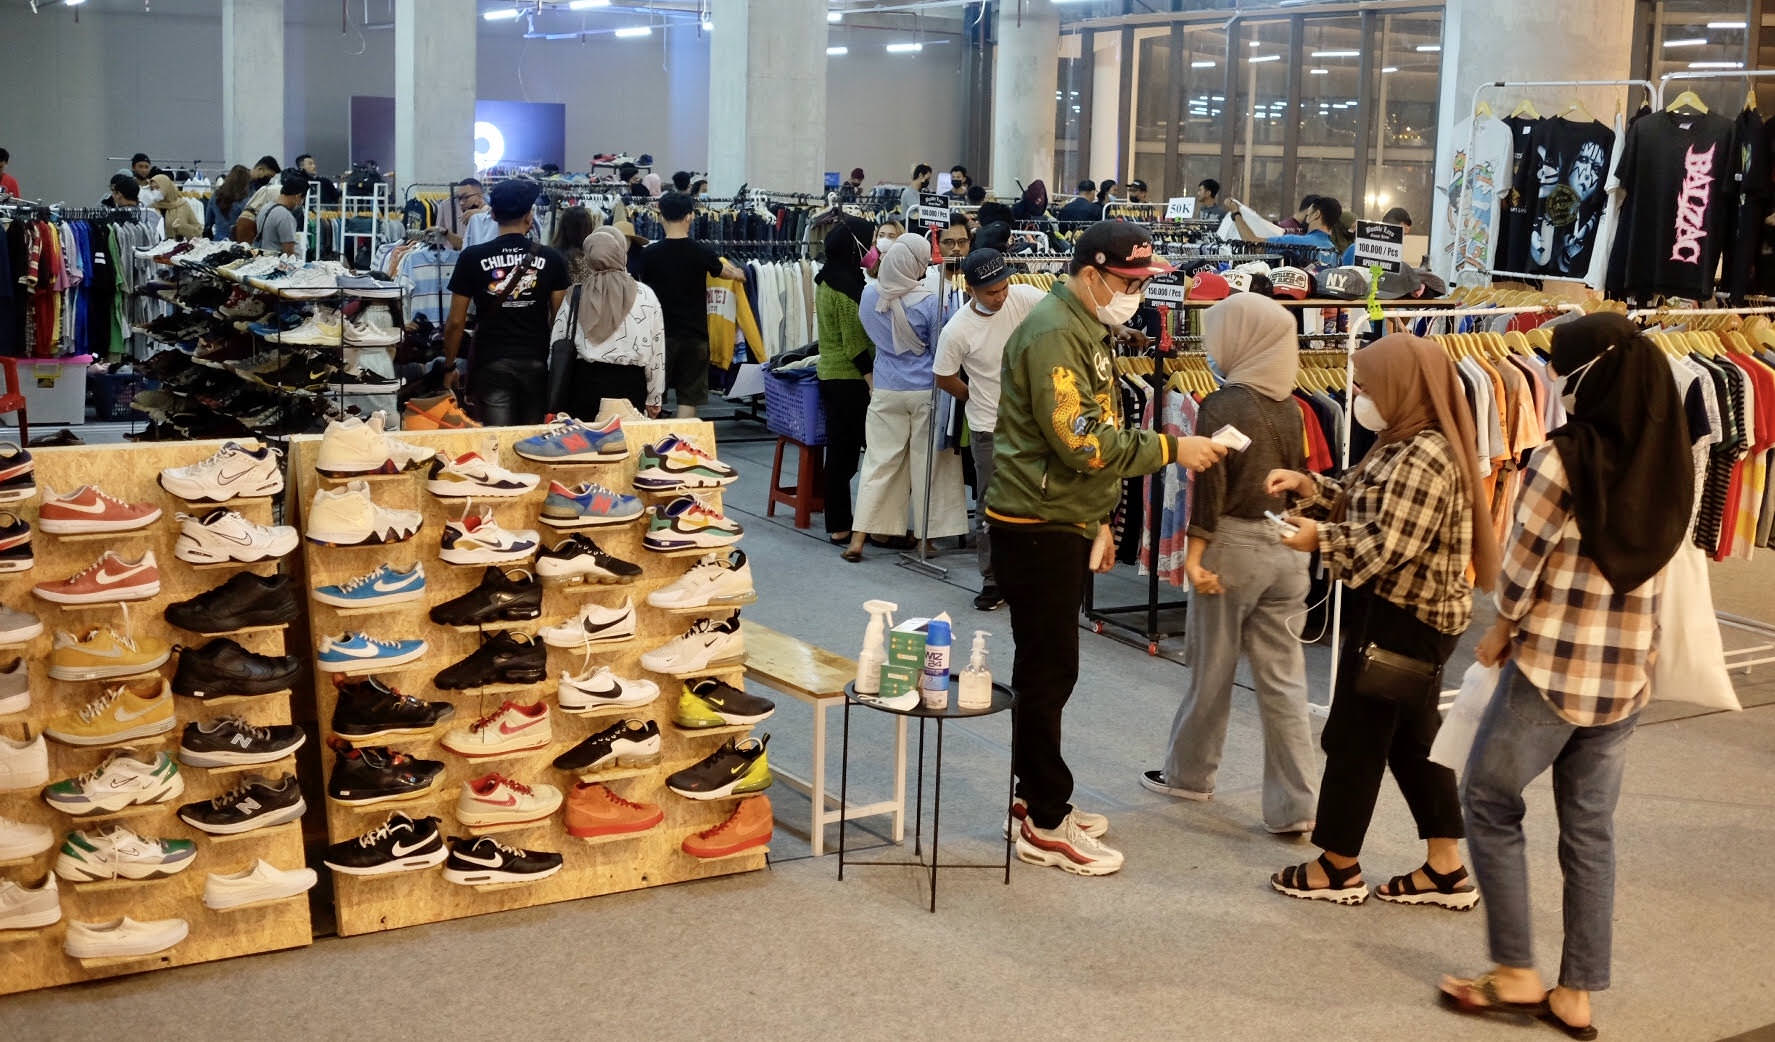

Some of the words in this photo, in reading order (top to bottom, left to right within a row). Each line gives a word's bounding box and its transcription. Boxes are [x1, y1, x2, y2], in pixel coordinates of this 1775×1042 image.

[1170, 203, 1190, 214] 50K
[1669, 142, 1717, 265] BALZAC
[1359, 242, 1383, 256] 100.000
[1387, 247, 1399, 258] Pcs
[1326, 272, 1348, 288] NY
[1148, 287, 1168, 297] 150.000
[231, 733, 253, 749] N
[236, 797, 262, 815] N
